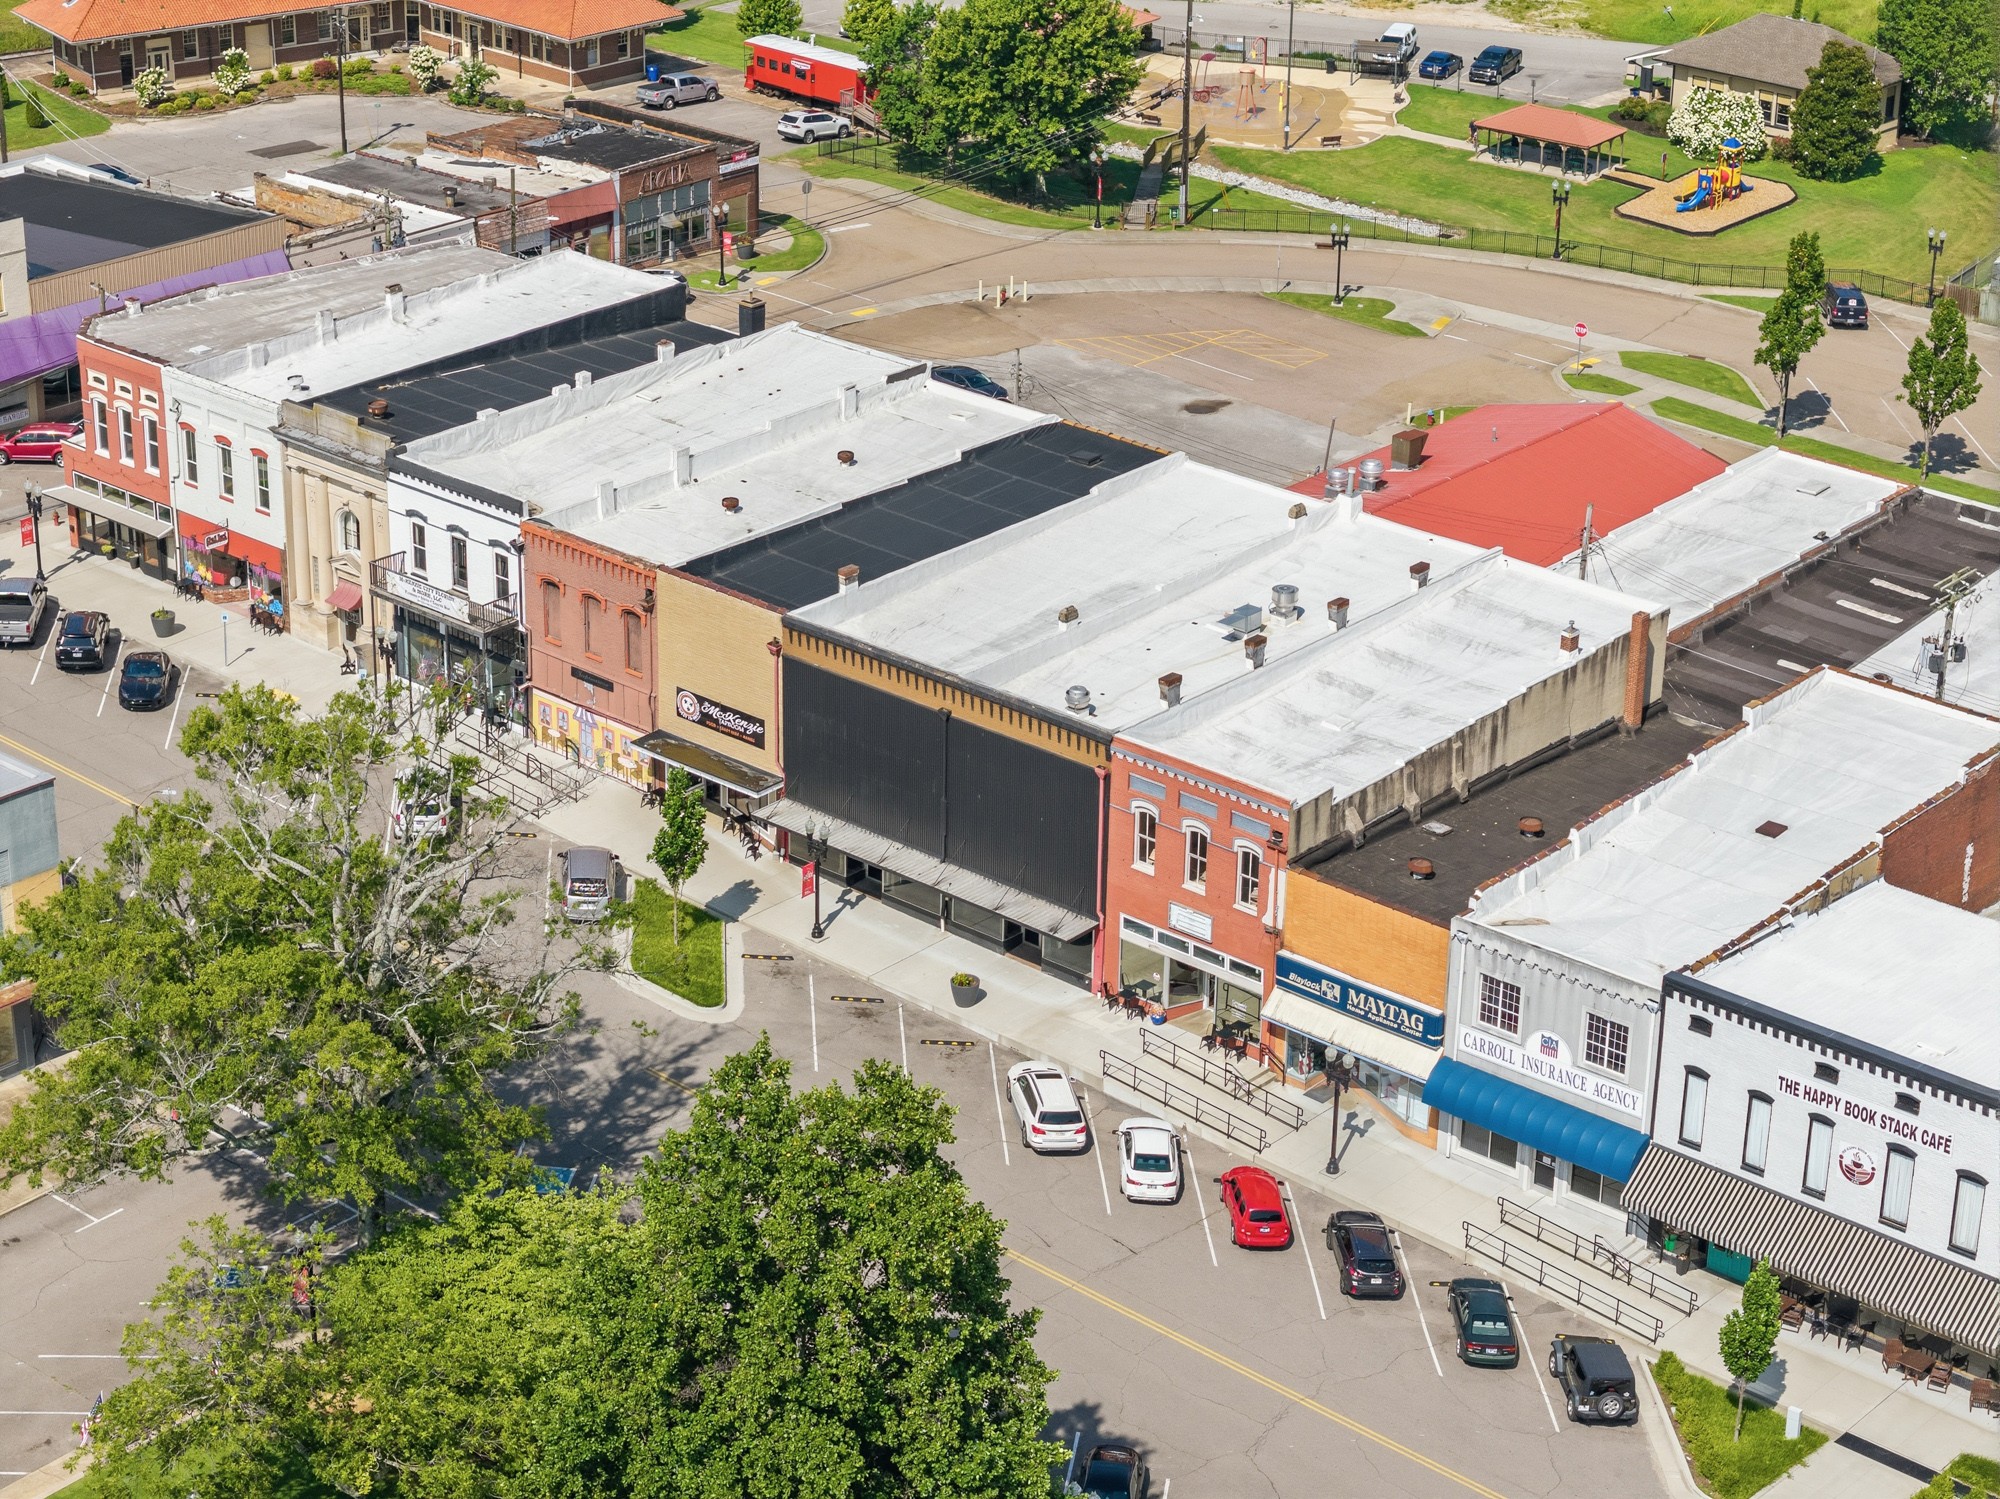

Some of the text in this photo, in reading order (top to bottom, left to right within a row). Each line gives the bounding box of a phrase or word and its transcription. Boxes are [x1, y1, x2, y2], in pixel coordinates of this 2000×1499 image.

[639, 163, 694, 194] ARCADIA
[701, 704, 763, 734] McKenzie
[1289, 973, 1321, 991] Blaylock
[1347, 1004, 1422, 1037] Home Appliance Center
[1348, 988, 1423, 1031] MAYTAG
[1540, 1037, 1558, 1049] CIA
[1464, 1032, 1638, 1111] CARROLL INSURANCE AGENCY
[1778, 1074, 1953, 1154] THE HAPPY BOOK STACK CAFÉ
